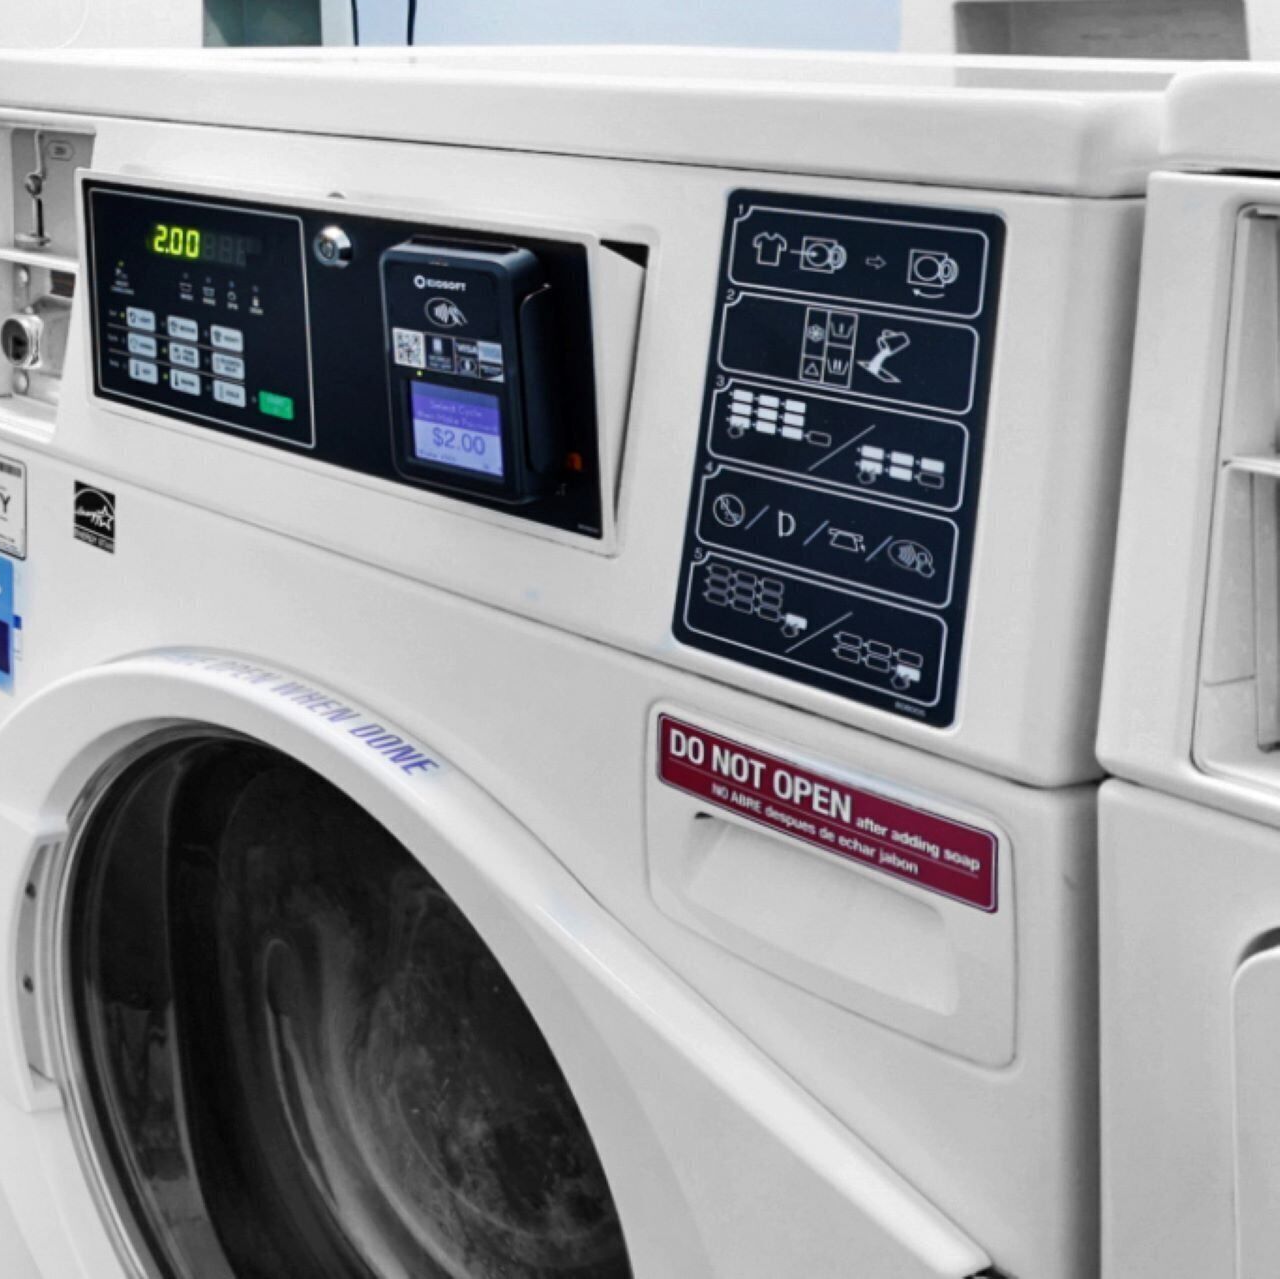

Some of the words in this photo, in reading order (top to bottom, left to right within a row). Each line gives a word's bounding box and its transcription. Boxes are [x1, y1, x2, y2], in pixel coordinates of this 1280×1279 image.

[153, 224, 201, 258] 2.00
[726, 288, 736, 301] 2
[716, 375, 726, 388] 3
[433, 426, 486, 456] $2.00
[694, 548, 703, 560] 5
[271, 680, 361, 724] WHEN
[348, 722, 440, 776] DONE
[669, 728, 705, 766] DO
[712, 745, 767, 790] NOT
[773, 770, 852, 824] OPEN
[856, 815, 888, 838] after
[891, 828, 940, 859] adding
[944, 846, 981, 872] soap
[731, 789, 763, 815] ABRE
[765, 802, 817, 836] despues
[819, 822, 836, 842] de
[838, 830, 876, 858] echar
[879, 845, 919, 876] jabon
